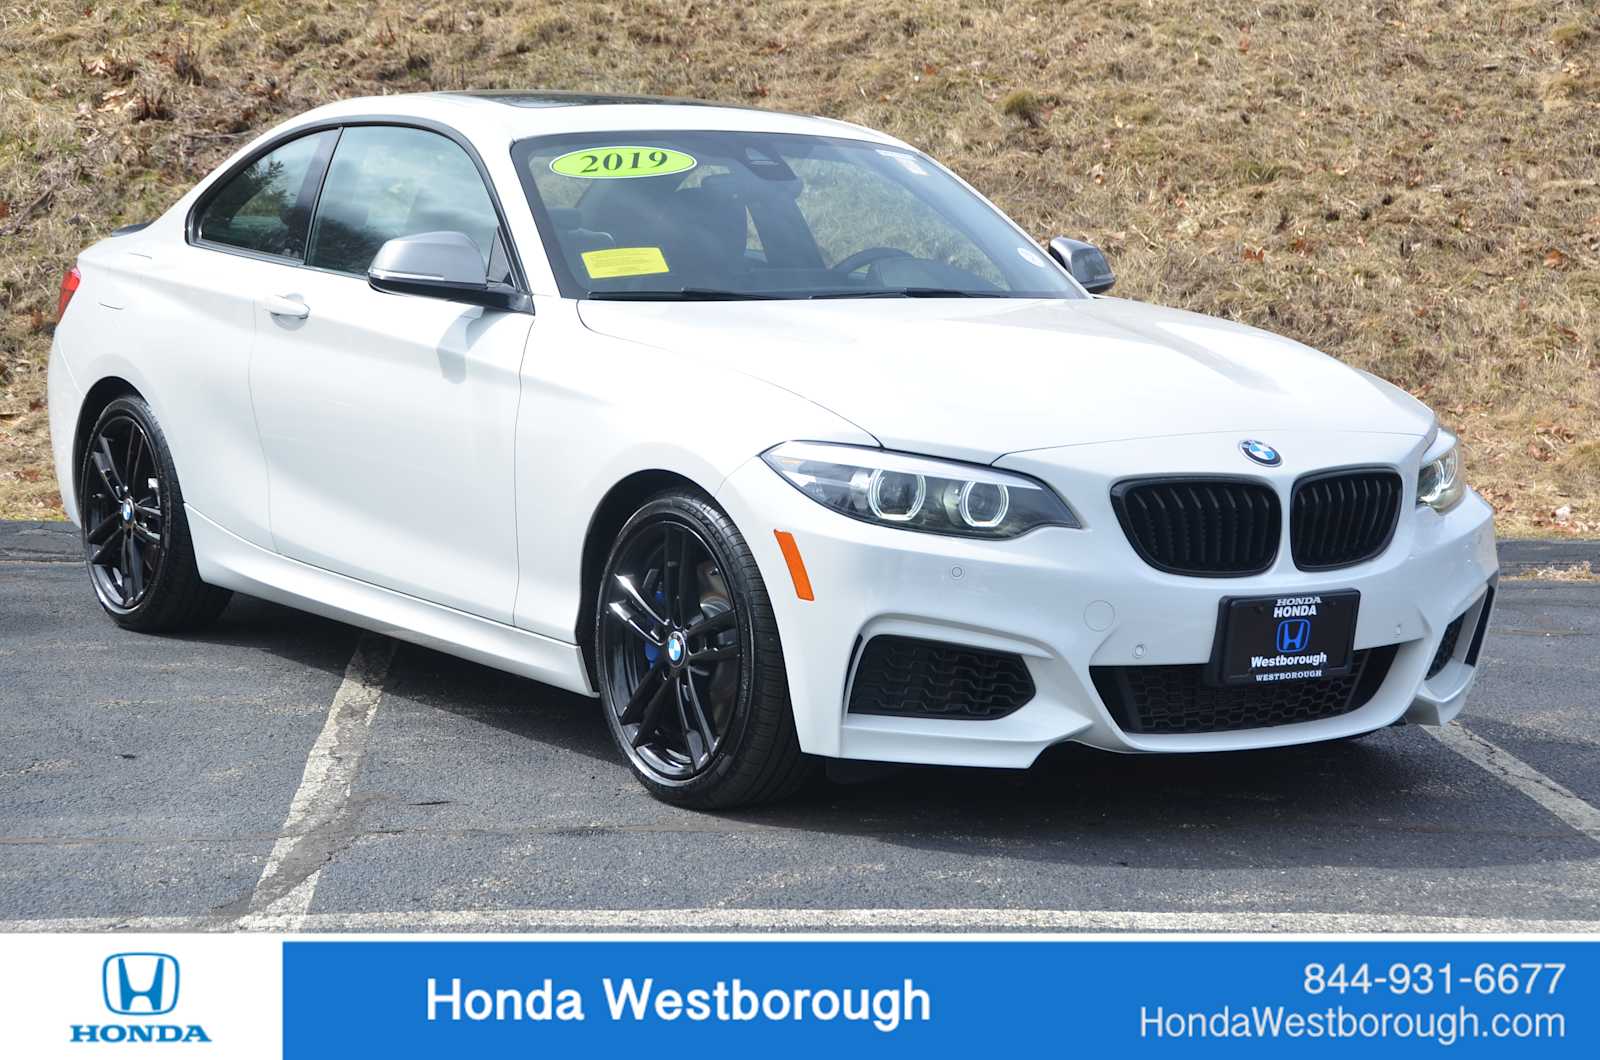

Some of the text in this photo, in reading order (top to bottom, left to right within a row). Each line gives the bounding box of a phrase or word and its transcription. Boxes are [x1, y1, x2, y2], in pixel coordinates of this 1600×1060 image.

[580, 151, 668, 173] 2019
[1275, 596, 1322, 607] HONDA
[1273, 604, 1317, 618] HONDA
[1250, 651, 1327, 668] Westborough
[1255, 669, 1322, 682] WESTBOROUGH
